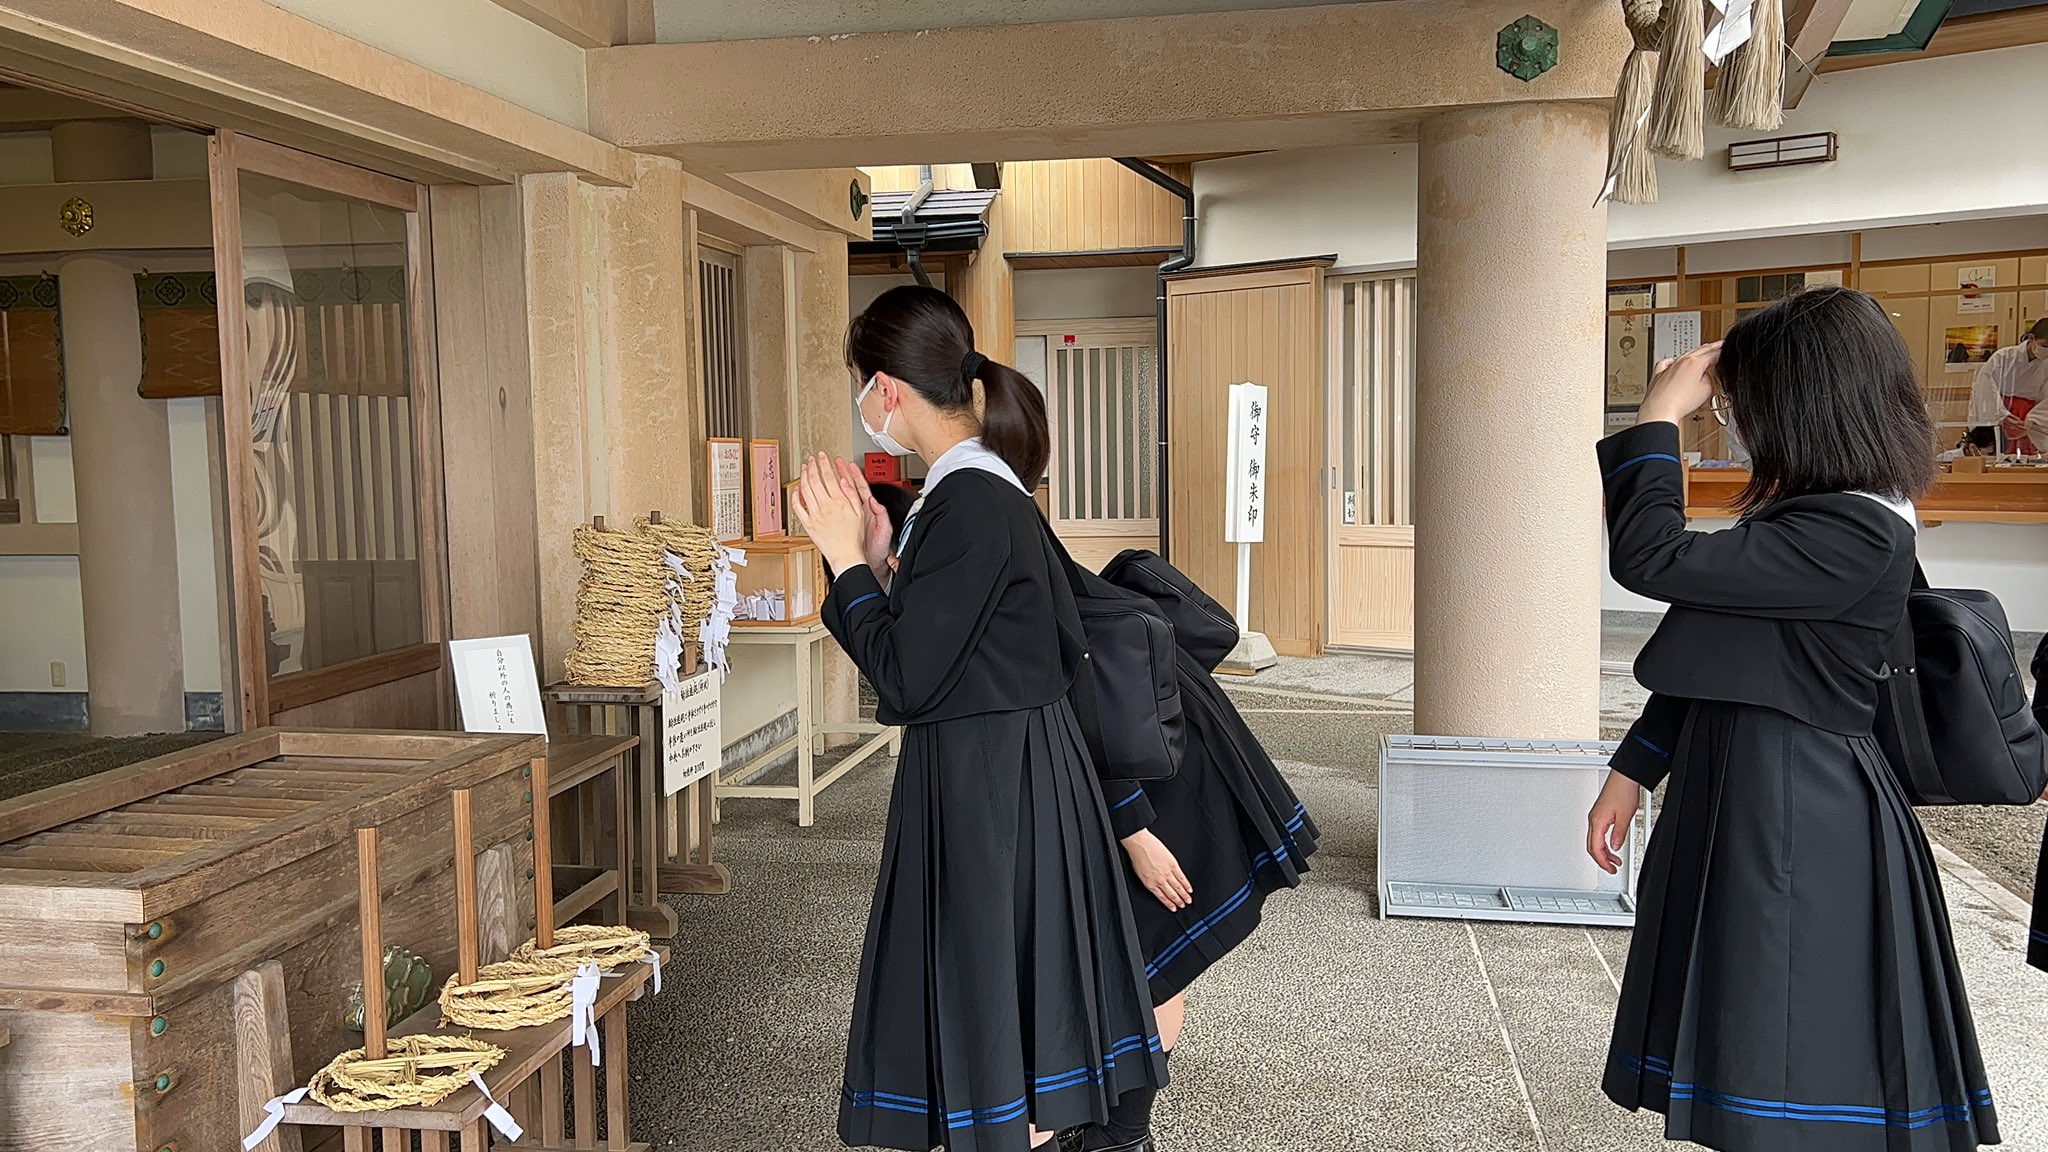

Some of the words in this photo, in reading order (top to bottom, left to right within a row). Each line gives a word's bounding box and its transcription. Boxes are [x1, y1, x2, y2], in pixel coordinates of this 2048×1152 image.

[1250, 400, 1262, 446] 御守
[1247, 458, 1260, 528] 御朱印
